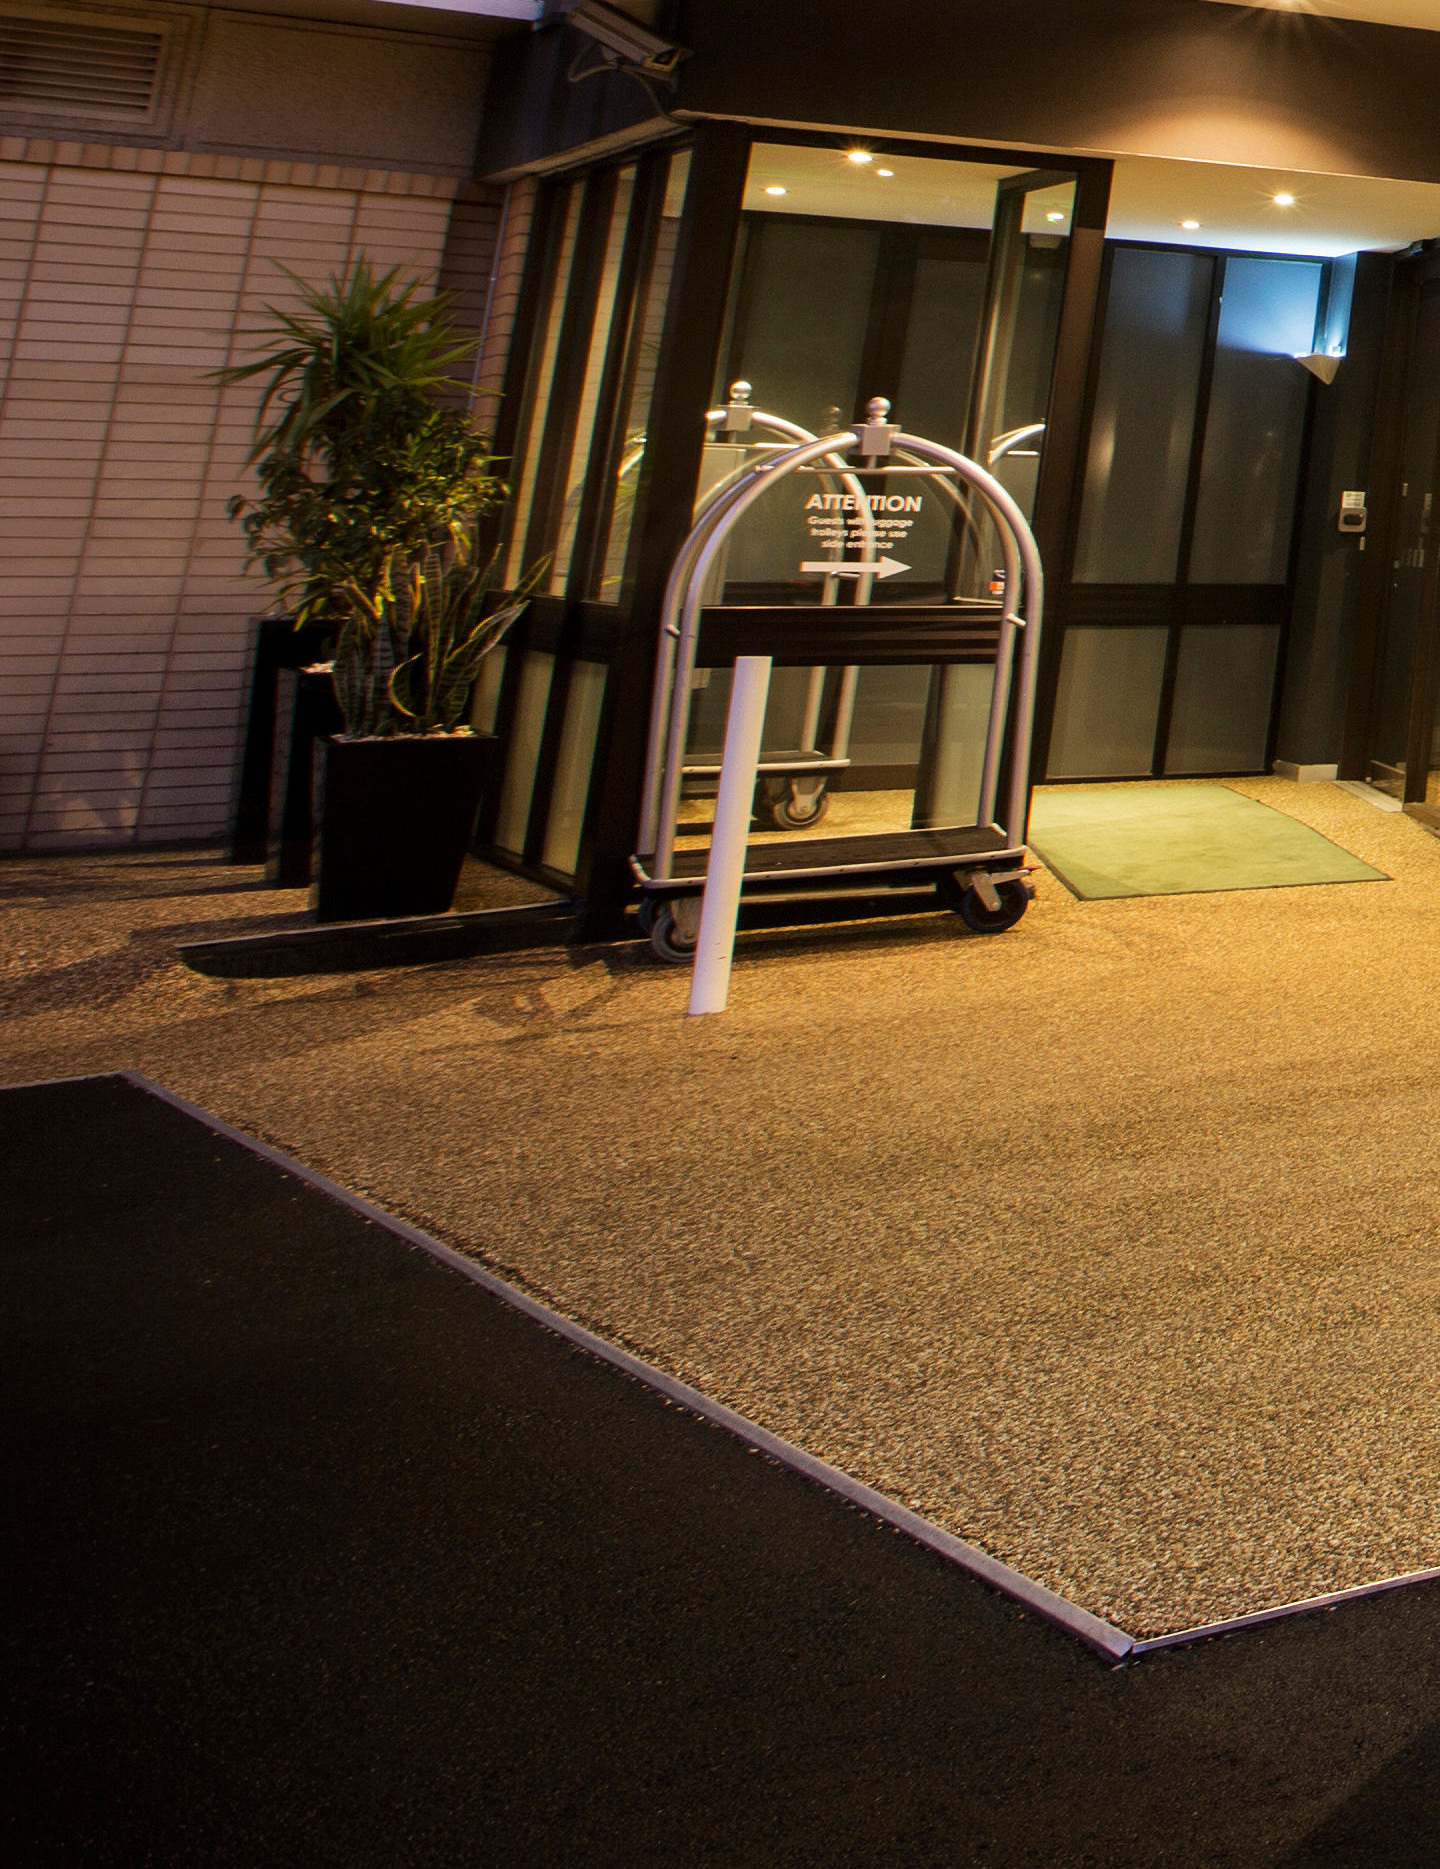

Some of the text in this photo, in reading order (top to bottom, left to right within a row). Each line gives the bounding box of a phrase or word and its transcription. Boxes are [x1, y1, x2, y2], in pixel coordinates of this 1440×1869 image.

[803, 494, 922, 512] ATTENTION
[850, 529, 886, 538] plese
[846, 541, 894, 549] entrnce
